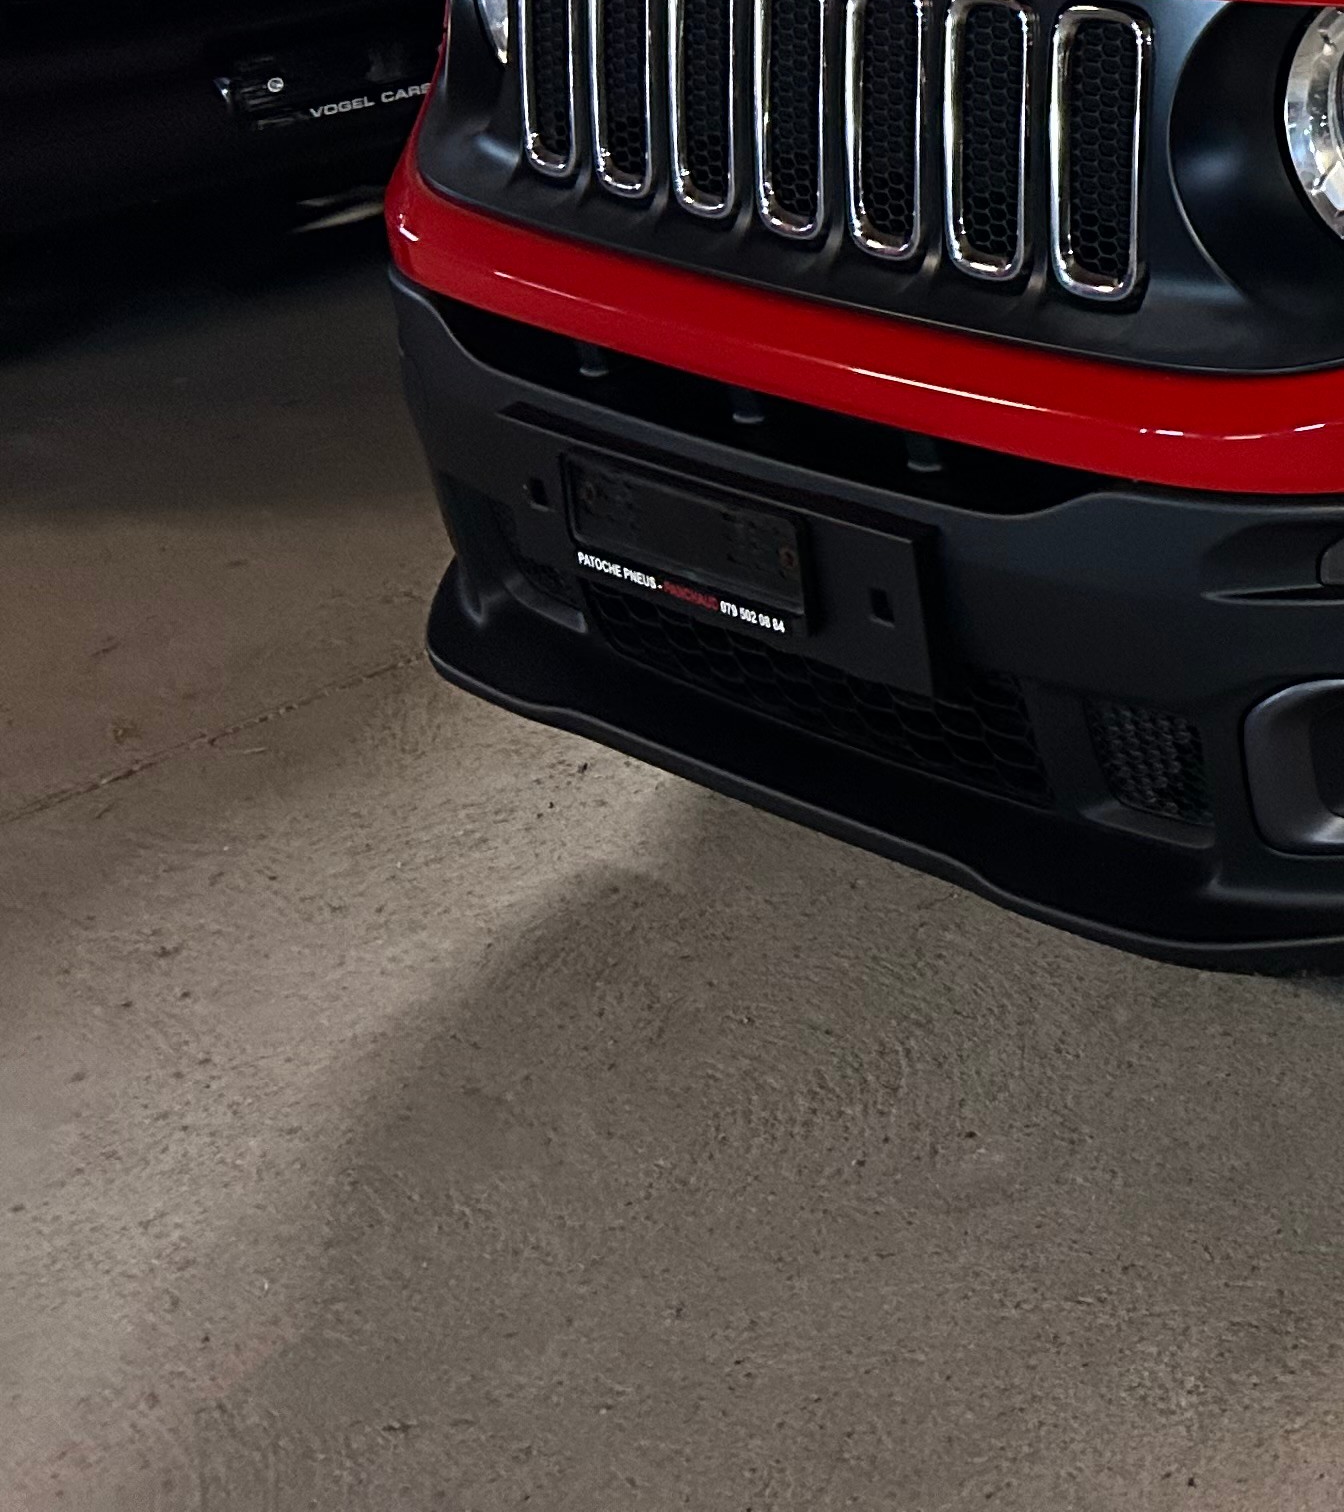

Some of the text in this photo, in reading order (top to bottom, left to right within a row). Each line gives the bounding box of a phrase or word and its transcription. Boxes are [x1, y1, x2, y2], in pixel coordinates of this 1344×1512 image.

[310, 82, 432, 118] VOGEL CARS
[577, 551, 622, 578] PATOCHE
[623, 567, 657, 590] PNEUS
[719, 600, 739, 618] 079
[739, 606, 758, 625] 502
